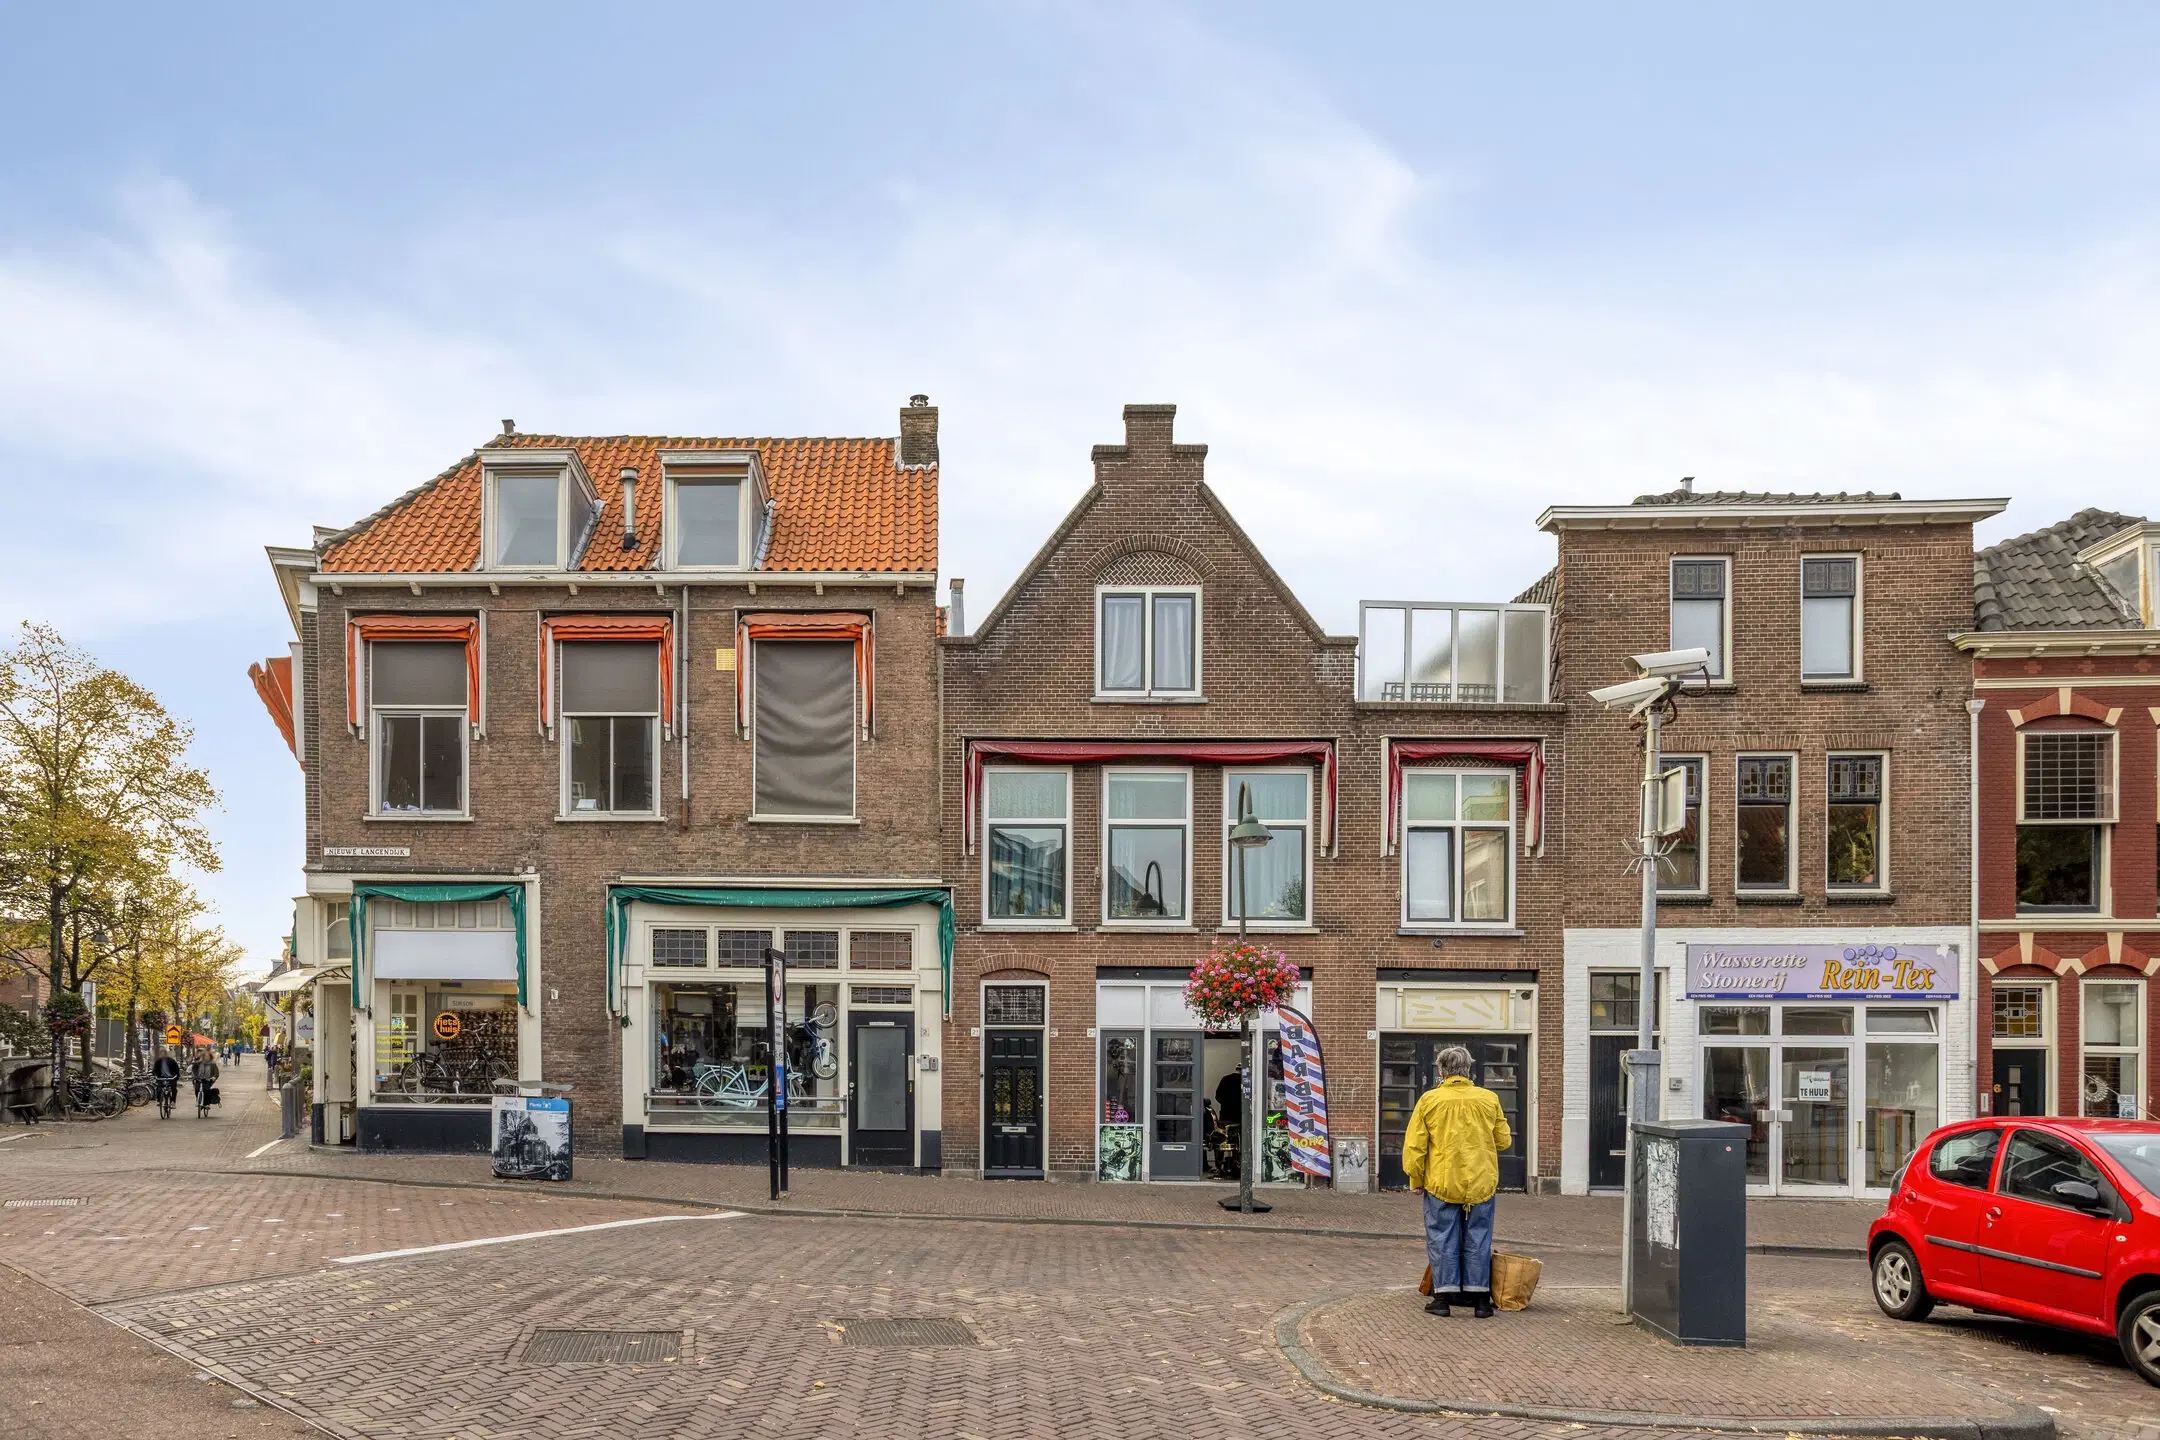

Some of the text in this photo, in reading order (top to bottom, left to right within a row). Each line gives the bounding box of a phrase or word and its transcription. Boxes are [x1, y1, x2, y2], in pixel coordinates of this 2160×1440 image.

[1702, 951, 1808, 969] Wasserette
[1700, 971, 1788, 993] Stomerij
[1818, 959, 1937, 990] Rein-Tex
[1800, 1088, 1829, 1097] TE HUUR
[1994, 1083, 2001, 1093] 6
